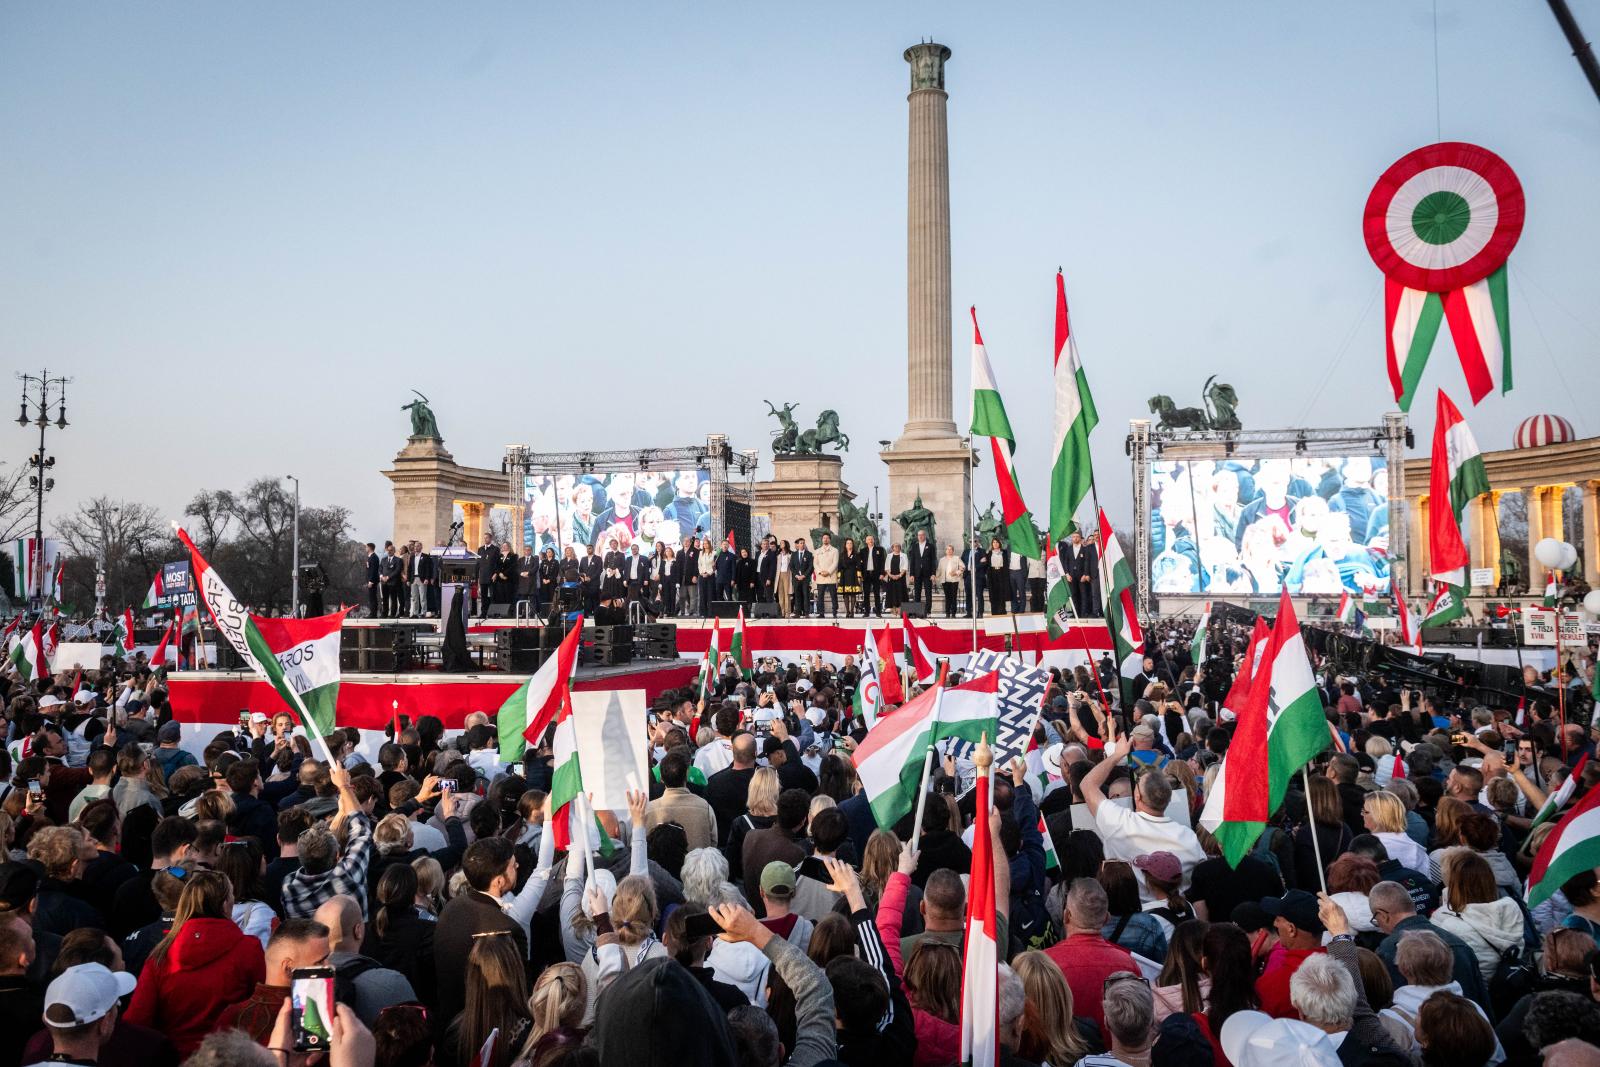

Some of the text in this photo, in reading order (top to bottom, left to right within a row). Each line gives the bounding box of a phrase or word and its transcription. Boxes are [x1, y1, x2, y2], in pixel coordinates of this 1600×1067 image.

[166, 571, 186, 583] MOST
[180, 593, 196, 606] TATA
[280, 644, 314, 671] ÁROS
